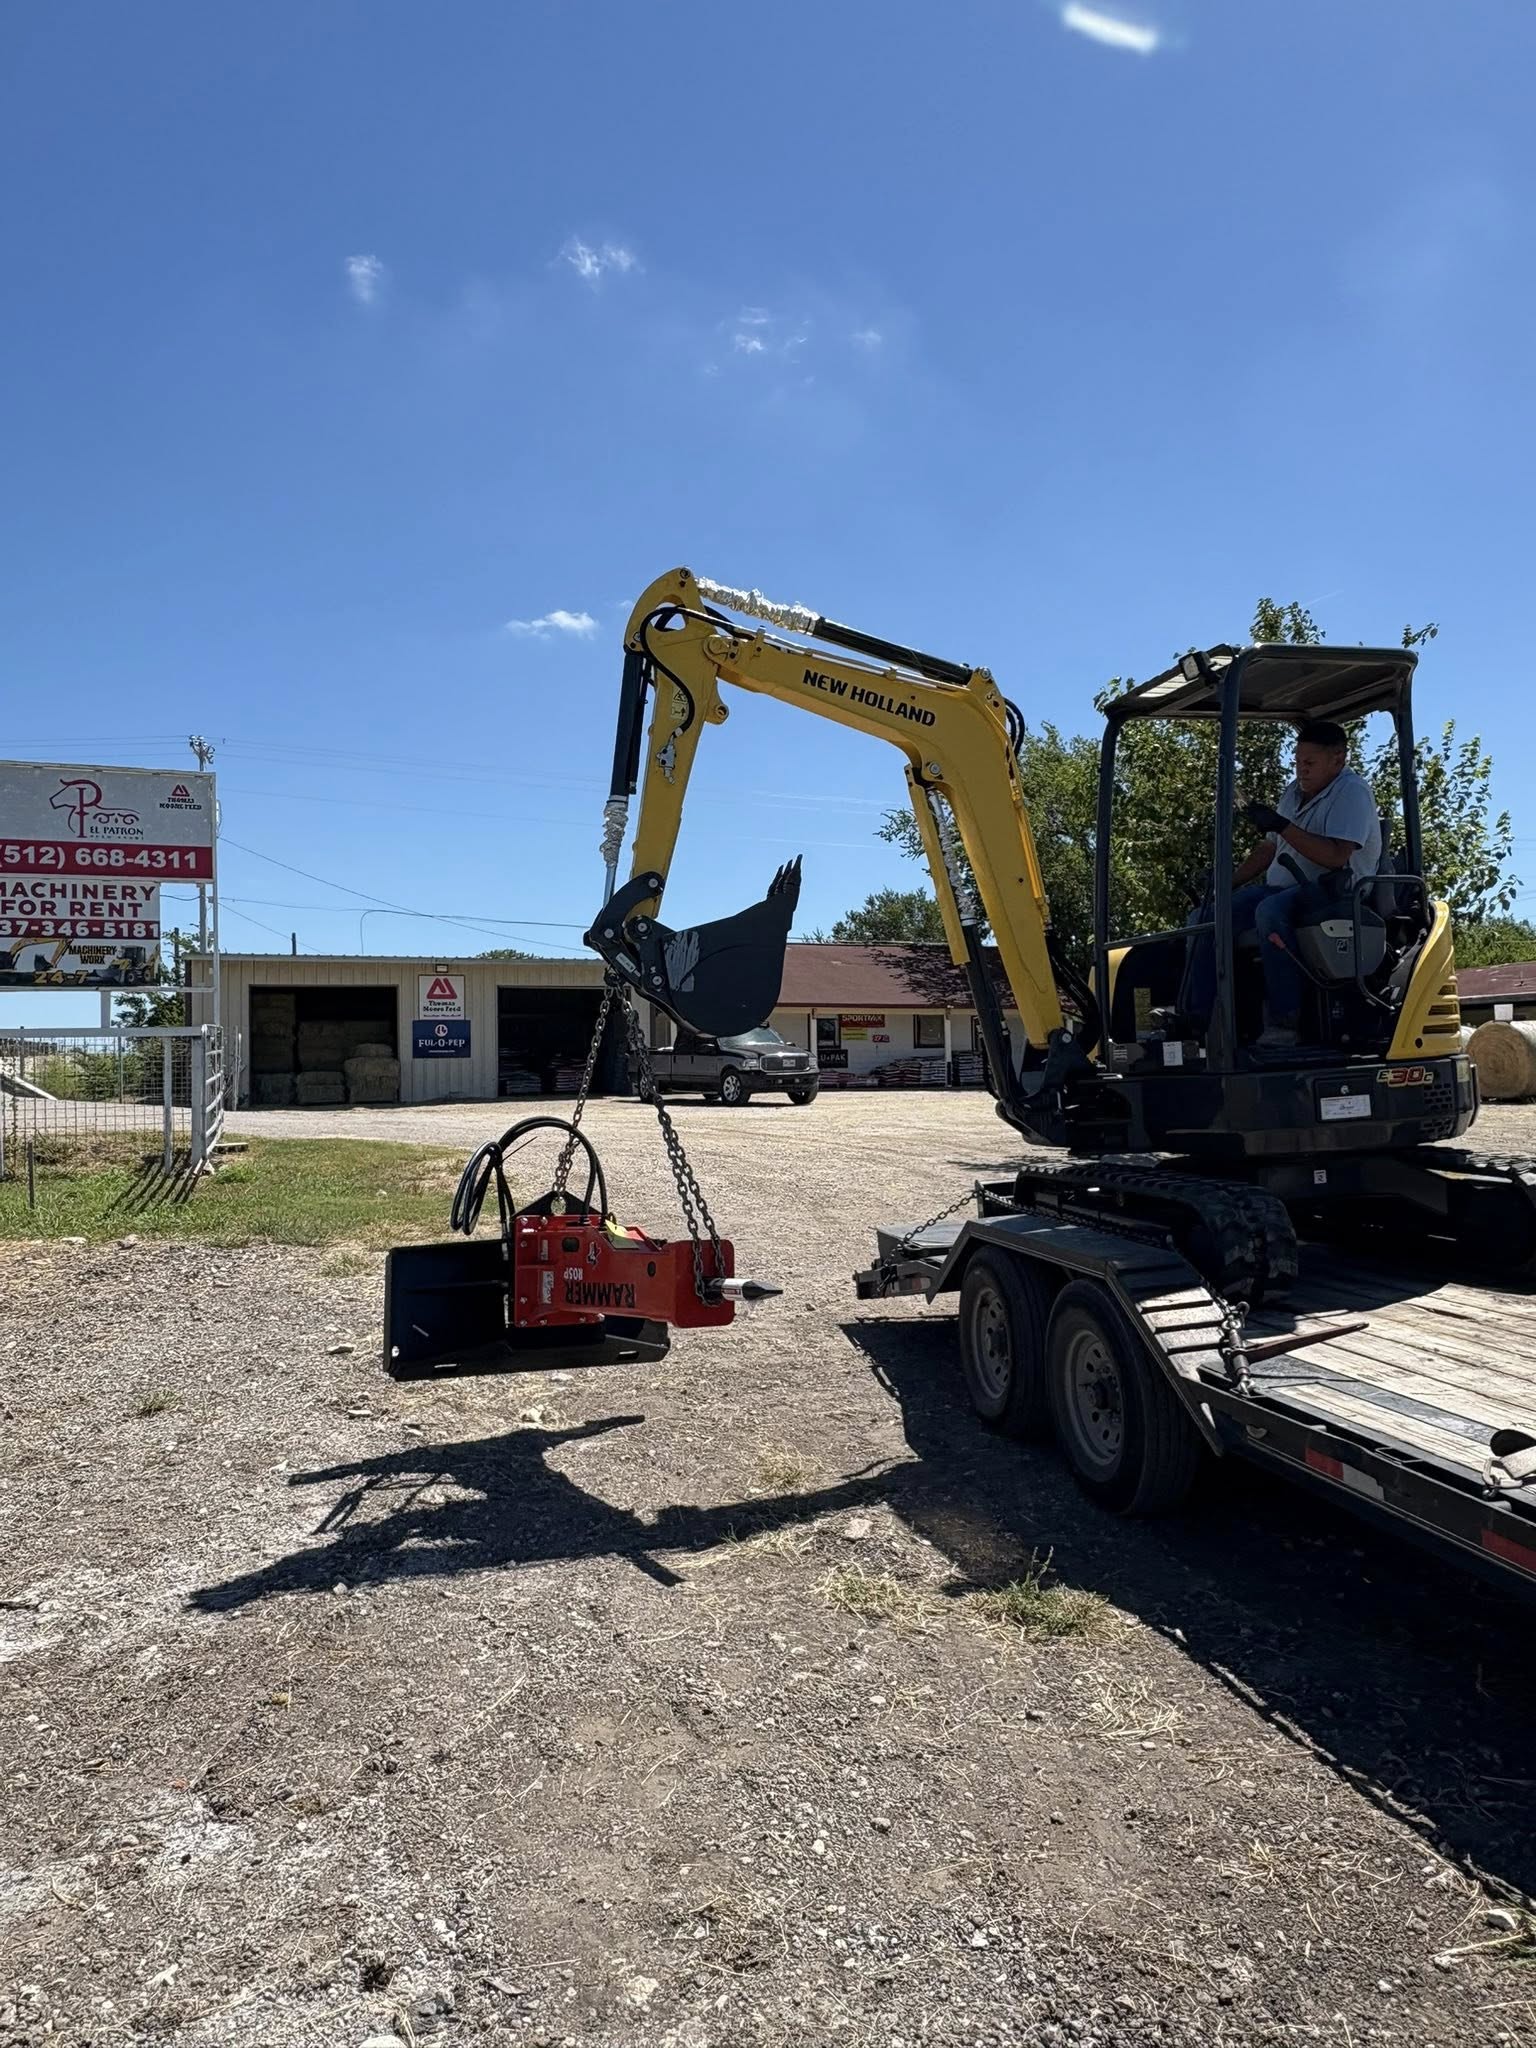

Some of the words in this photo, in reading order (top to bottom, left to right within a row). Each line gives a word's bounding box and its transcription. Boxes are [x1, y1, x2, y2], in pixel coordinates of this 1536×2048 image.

[803, 669, 849, 698] NEW
[850, 685, 937, 727] HOLLAND
[90, 826, 100, 834] EL
[103, 827, 144, 836] PATRON
[75, 848, 197, 869] 668-4311
[1, 900, 57, 916] FOR
[70, 901, 143, 918] RENT
[68, 945, 117, 955] MACHINERY
[33, 970, 89, 984] 24-7
[565, 1281, 635, 1308] RAMMER
